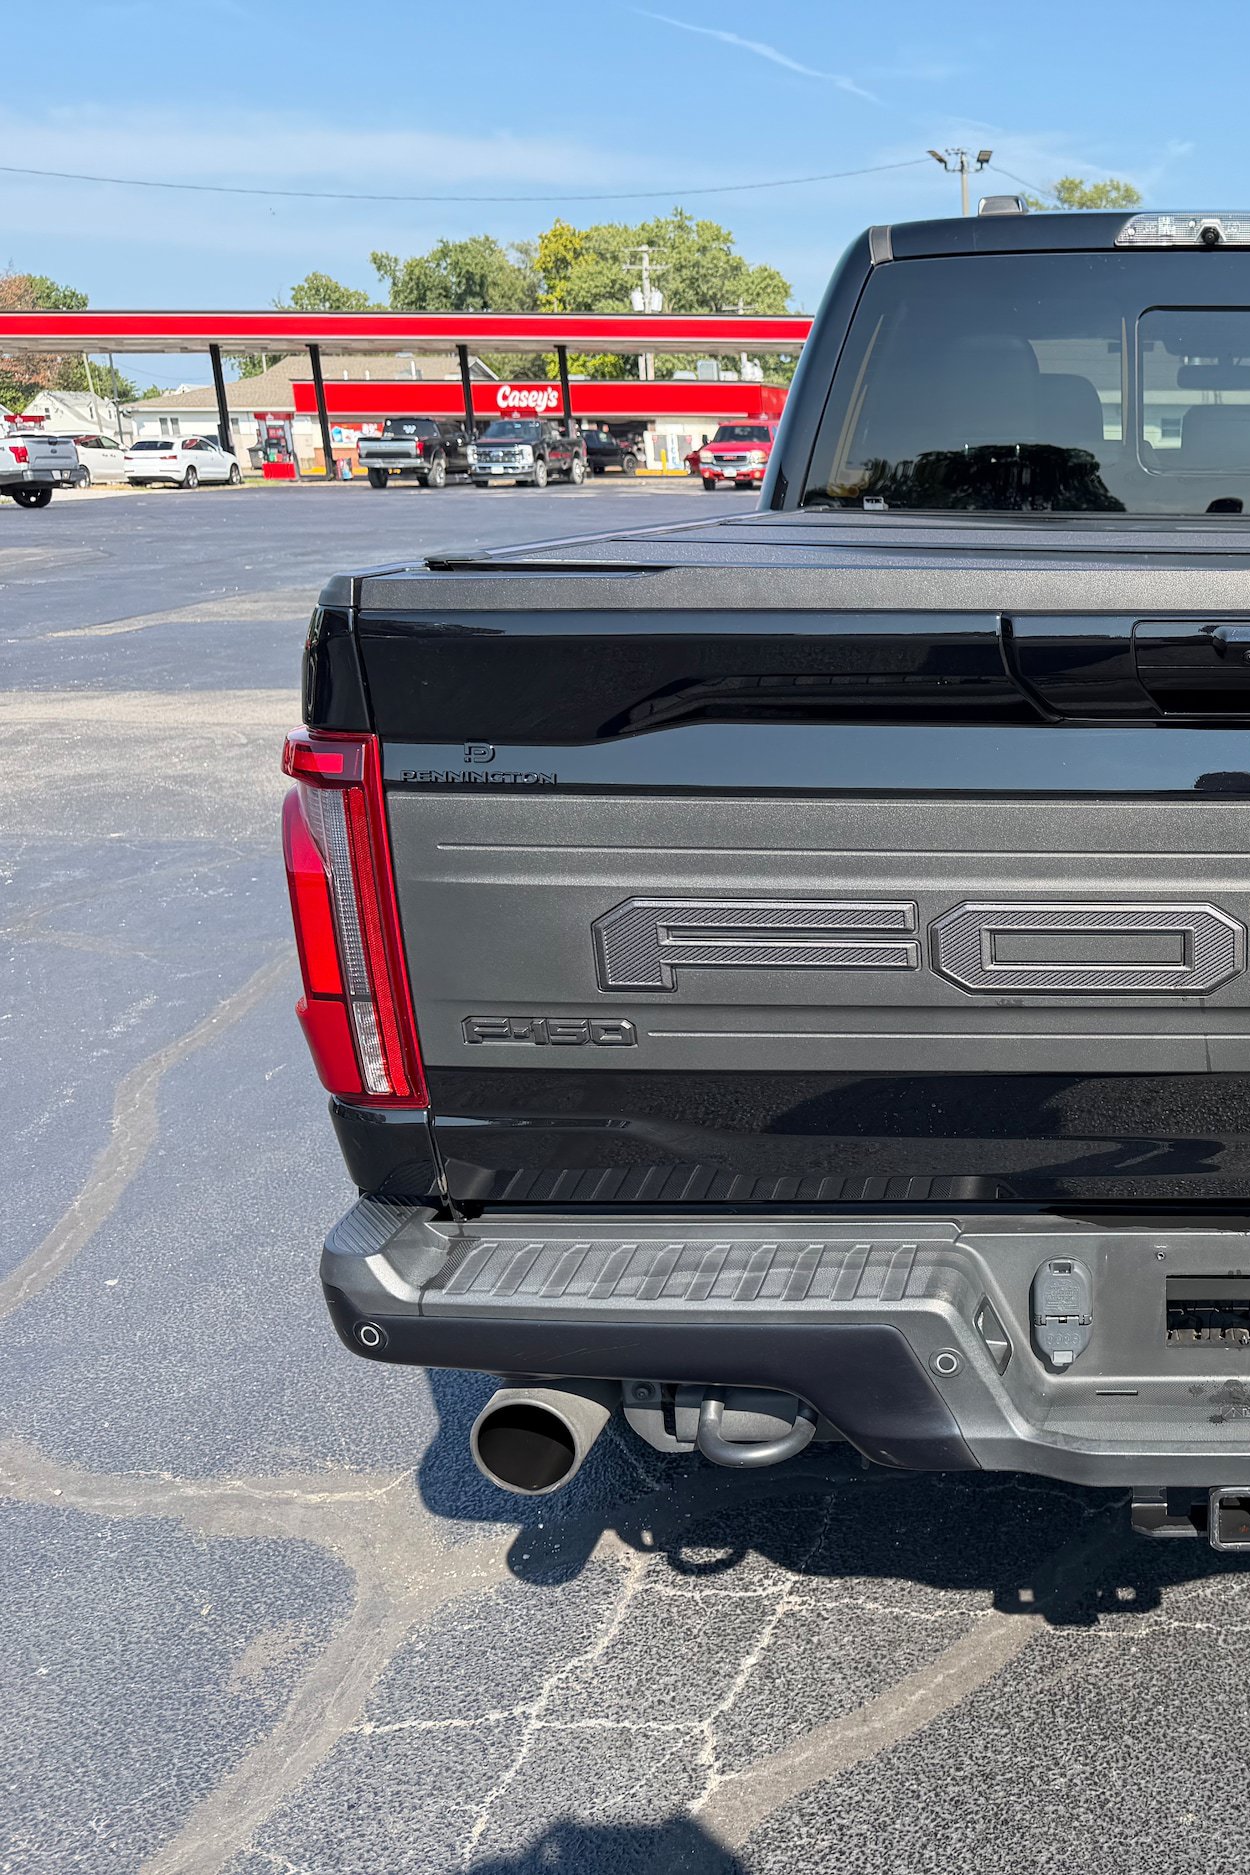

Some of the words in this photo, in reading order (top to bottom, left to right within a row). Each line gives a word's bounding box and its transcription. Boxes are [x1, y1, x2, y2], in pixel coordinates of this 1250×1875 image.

[496, 385, 559, 412] Casey's
[400, 769, 557, 785] PENNINGTON
[461, 1015, 638, 1047] F-150
